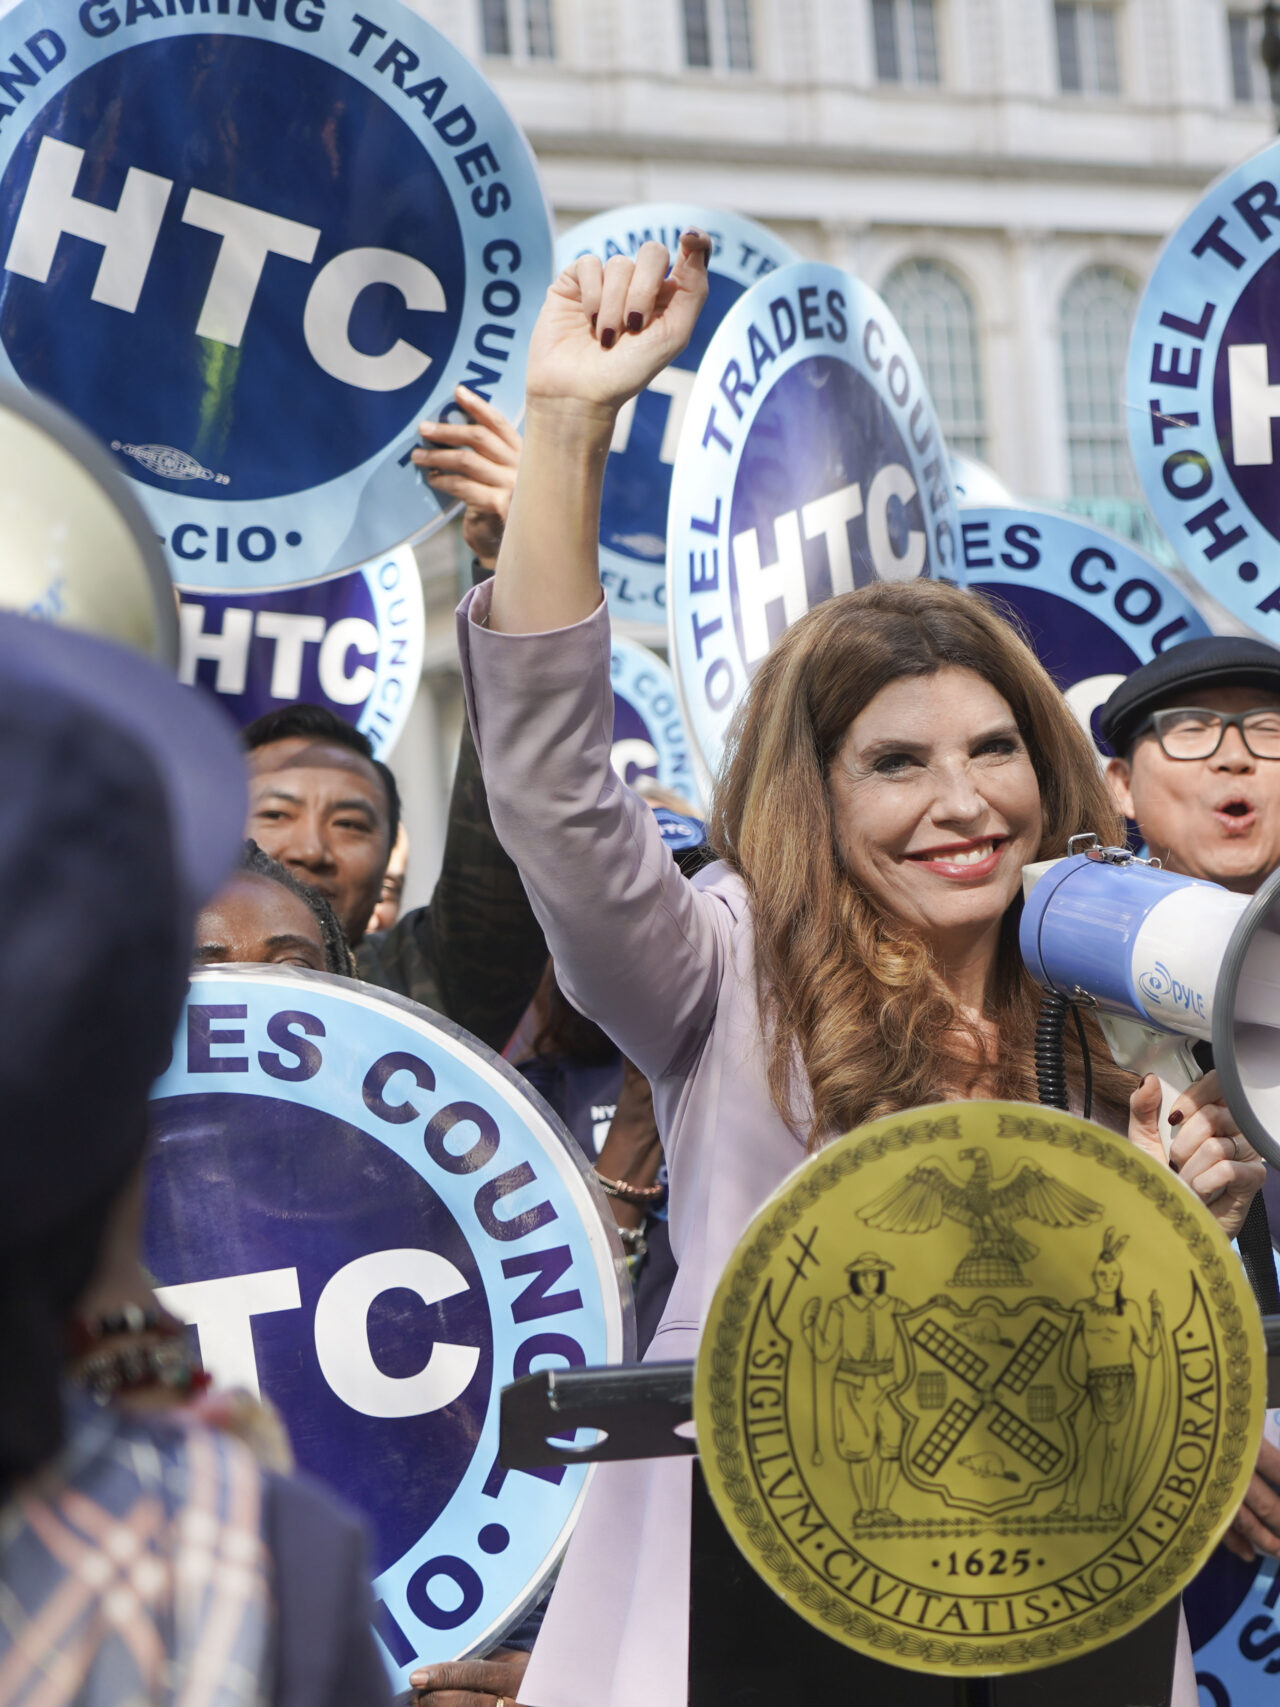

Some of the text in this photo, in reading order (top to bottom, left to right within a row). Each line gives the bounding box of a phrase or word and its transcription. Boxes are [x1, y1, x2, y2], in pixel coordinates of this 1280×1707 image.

[348, 14, 511, 218] TRADES
[4, 135, 447, 392] HTC
[703, 285, 847, 457] TRADES
[1149, 302, 1248, 561] HOTEL
[178, 602, 380, 706] HTC
[732, 463, 927, 666] HTC
[748, 1343, 1216, 1633] SIGILLVM CIVITATIS NOVI EBORACI
[946, 1548, 1032, 1577] 1625
